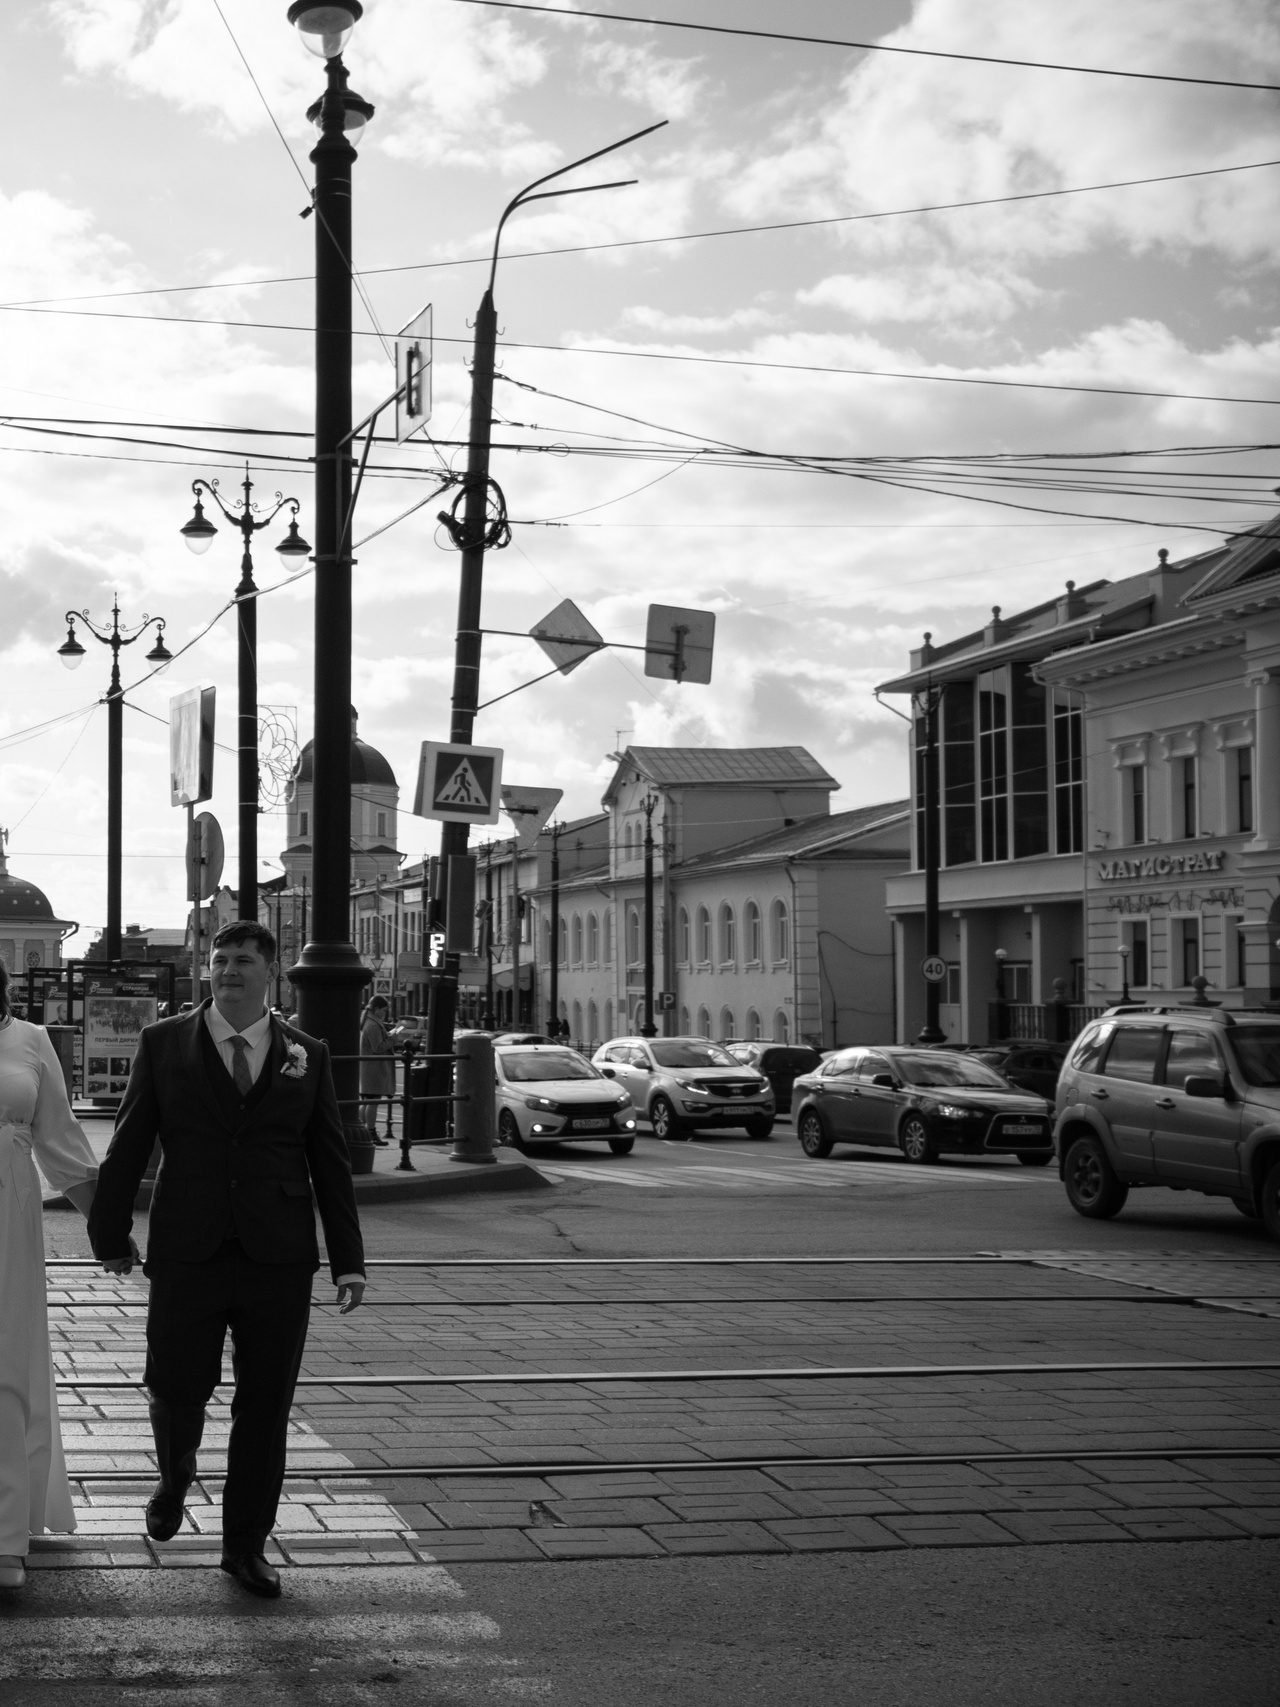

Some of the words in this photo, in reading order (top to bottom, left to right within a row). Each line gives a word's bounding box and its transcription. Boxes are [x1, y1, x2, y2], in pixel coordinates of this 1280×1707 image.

[1099, 851, 1223, 880] МАГИСТРАТ
[925, 963, 943, 976] 40
[663, 993, 675, 1009] P
